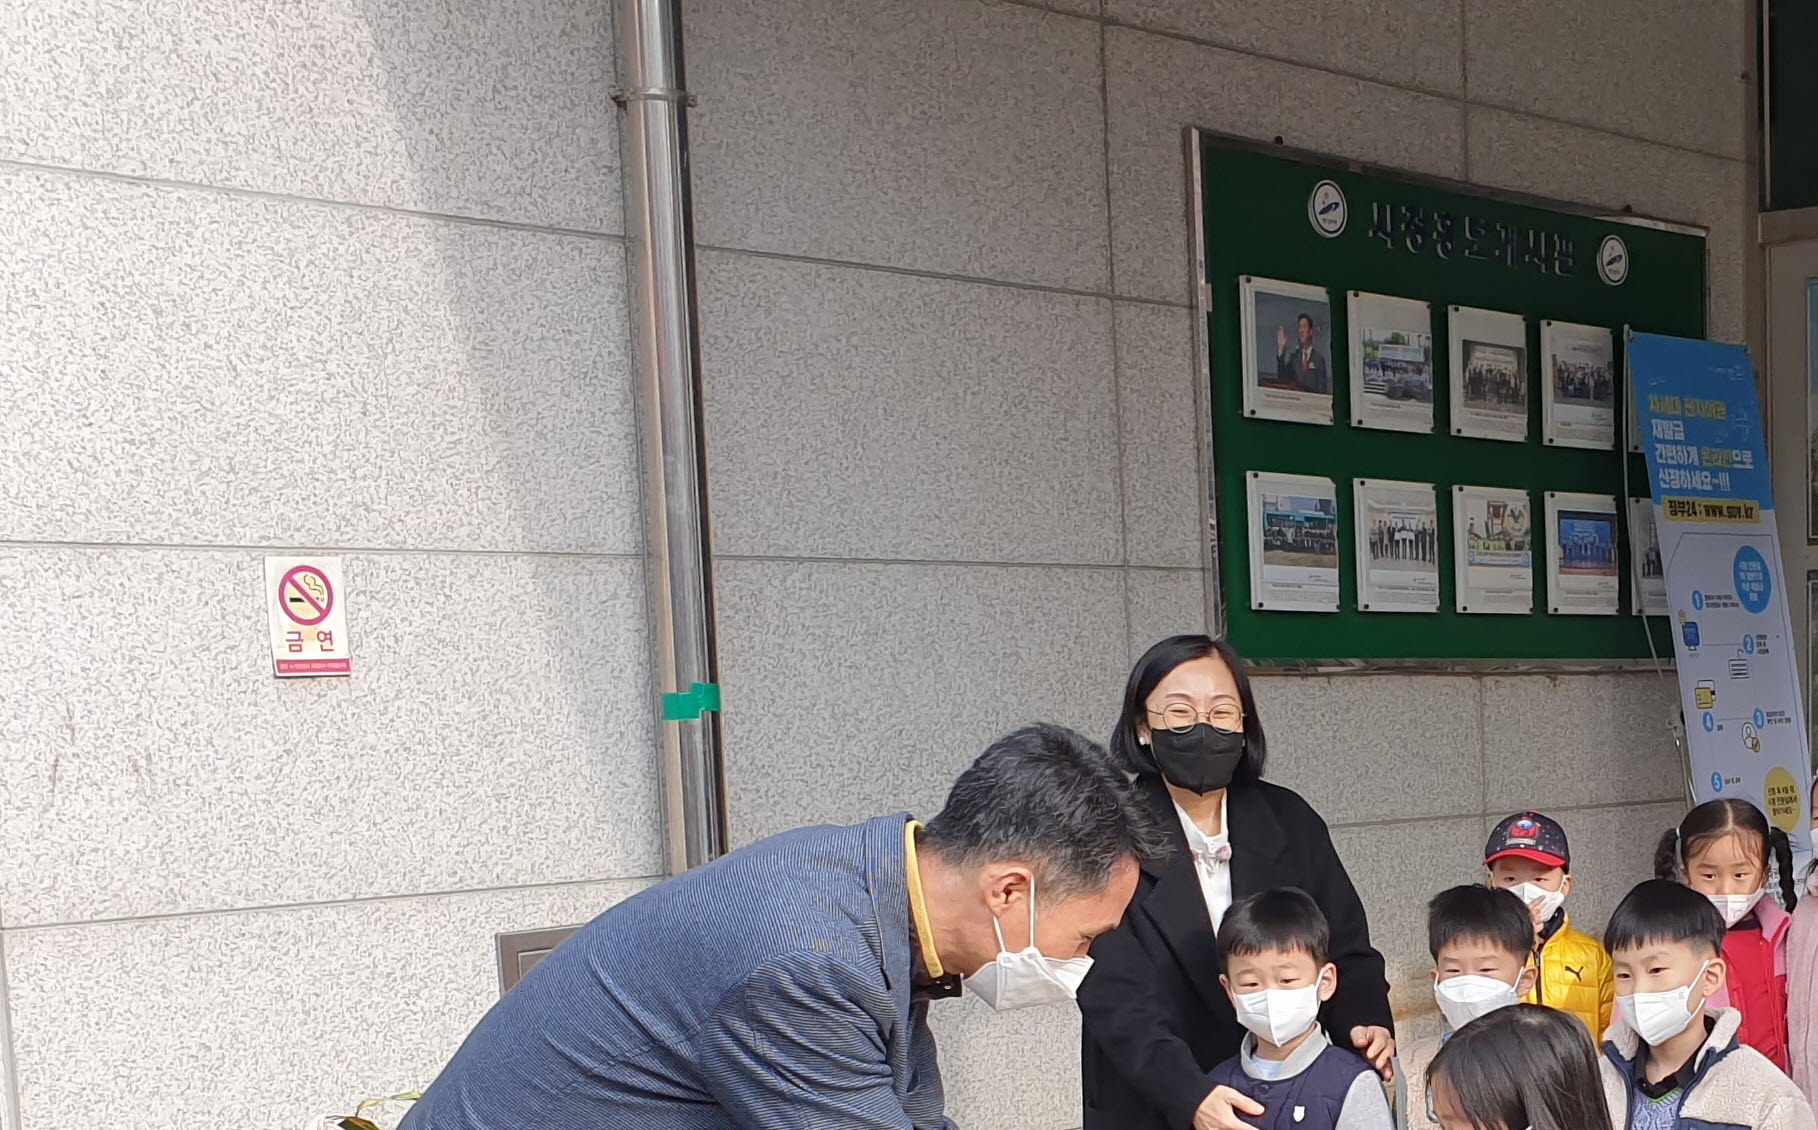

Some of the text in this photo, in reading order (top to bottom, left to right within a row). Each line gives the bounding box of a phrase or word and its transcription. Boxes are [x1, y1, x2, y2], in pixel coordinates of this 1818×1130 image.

[1651, 419, 1685, 440] 재발급
[1655, 443, 1699, 465] 간편하게
[286, 630, 334, 652] 금연
